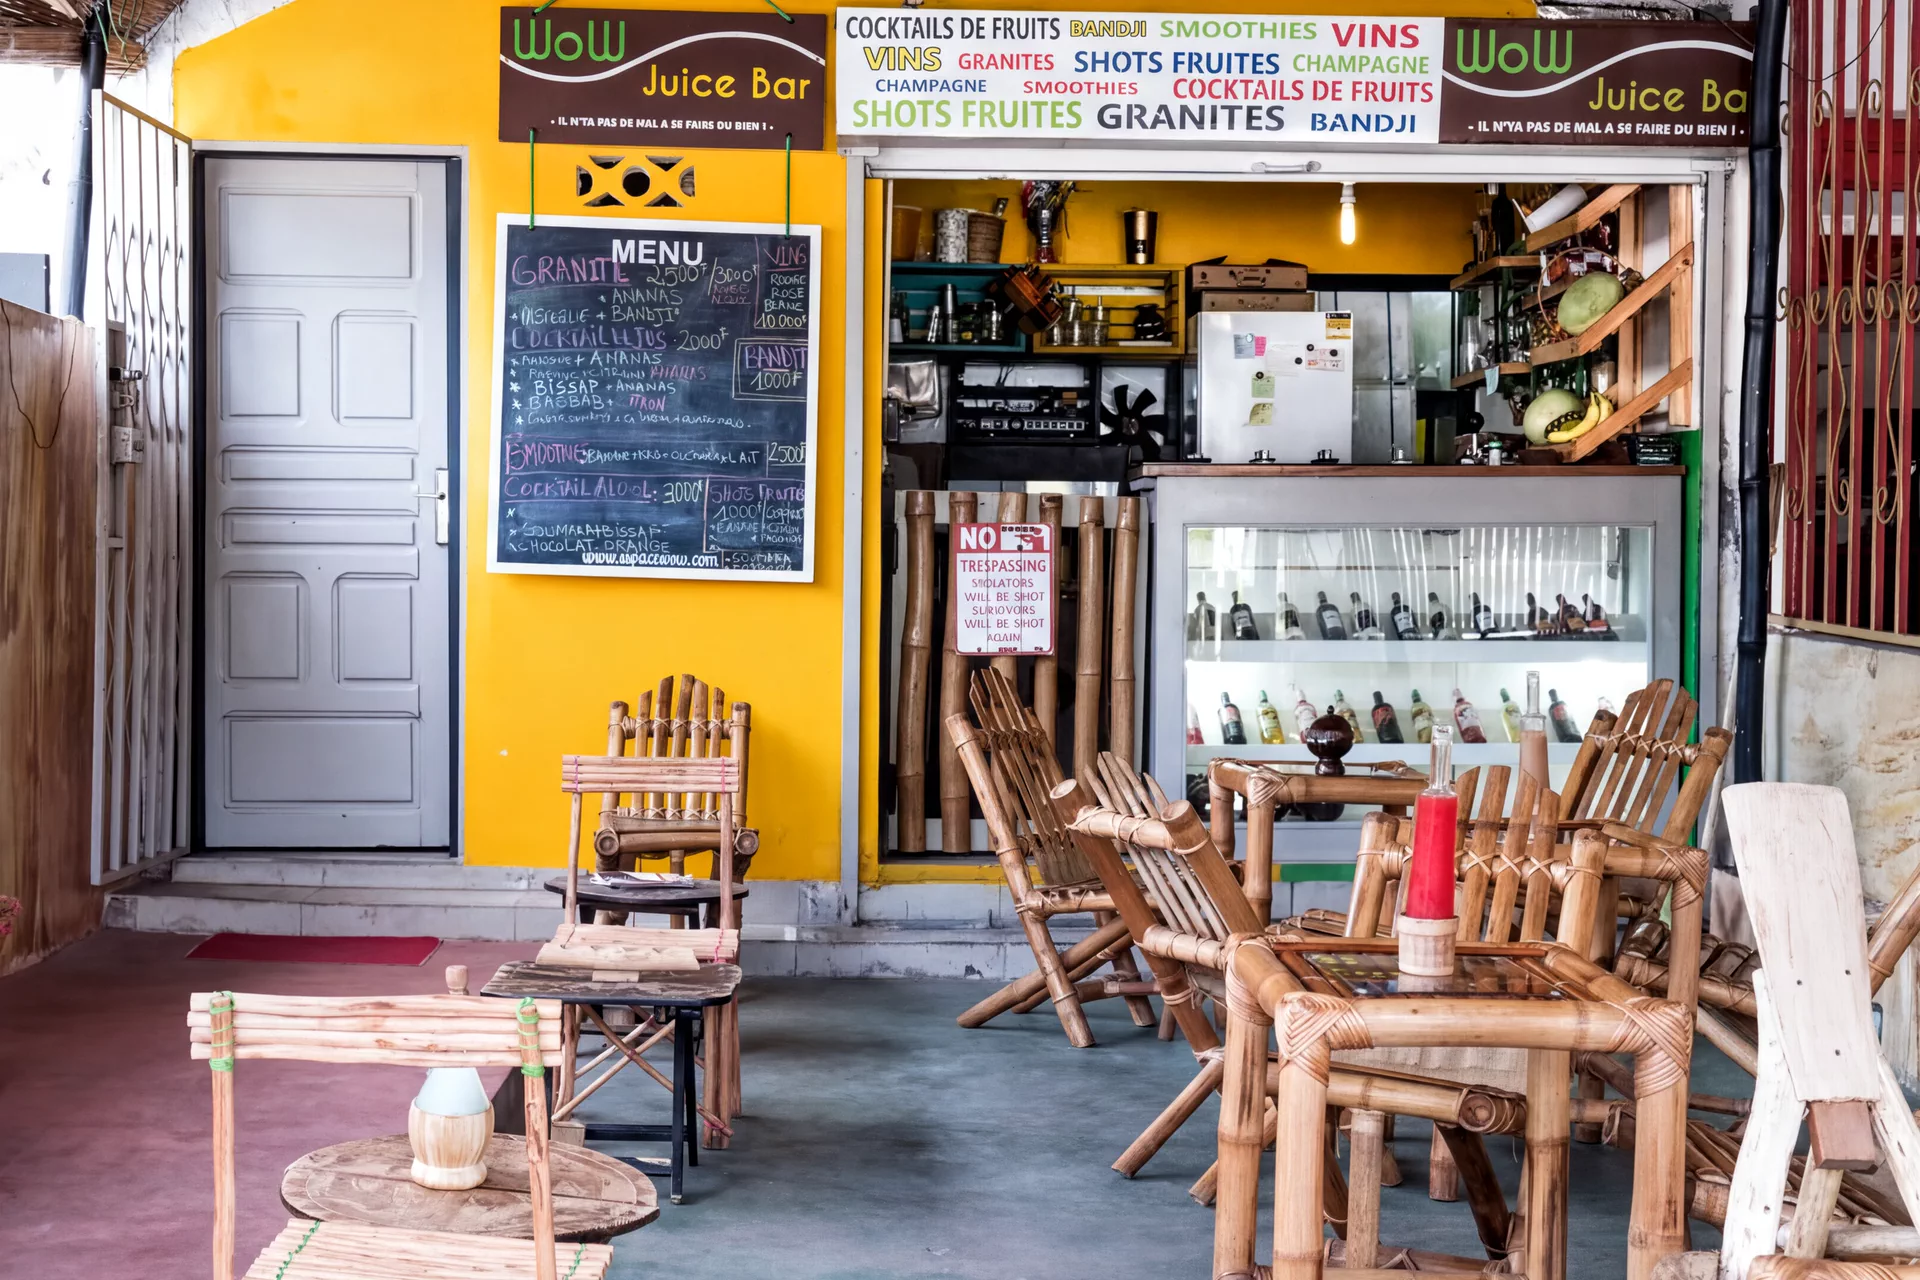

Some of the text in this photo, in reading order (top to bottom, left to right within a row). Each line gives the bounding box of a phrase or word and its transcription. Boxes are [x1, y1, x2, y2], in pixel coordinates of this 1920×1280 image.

[514, 19, 625, 62] WoW
[846, 16, 1420, 48] COCKTAILS DE FRUITS BANDJI SMOOTHIES VINS
[863, 46, 1429, 75] VINS GRANITES SHOTS FRUITES CHAMPAGNE
[1457, 29, 1573, 74] WoW
[642, 64, 810, 99] Juice Bar
[875, 78, 1433, 103] CHAMPAGNE SMOOTHIES COCKTAILS DE FRUITS
[1588, 77, 1747, 113] Juice Ba
[558, 117, 568, 126] IL
[597, 117, 617, 128] PAS
[619, 118, 634, 128] DE
[660, 119, 668, 129] A
[735, 121, 760, 131] BIEN
[853, 99, 1416, 133] SHOTS FRUITES GRANITES BANDJI
[1478, 121, 1489, 132] IL
[1493, 121, 1523, 132] N'YA
[1526, 121, 1551, 133] PAS
[1554, 122, 1571, 133] DE
[1574, 122, 1602, 134] MAL
[1604, 123, 1614, 134] A
[1636, 124, 1671, 135] FAIRE
[1674, 124, 1694, 135] DU
[1697, 125, 1727, 136] BIEN
[612, 239, 703, 266] MENU
[612, 287, 683, 305] ANANAS
[590, 350, 662, 367] ANANAS
[616, 379, 676, 394] ANANAS
[960, 527, 997, 550] NO
[960, 560, 1047, 573] TRESPASSING
[964, 592, 1045, 602] WILL BE SHOT
[964, 619, 1045, 629] WILL BE SHOT
